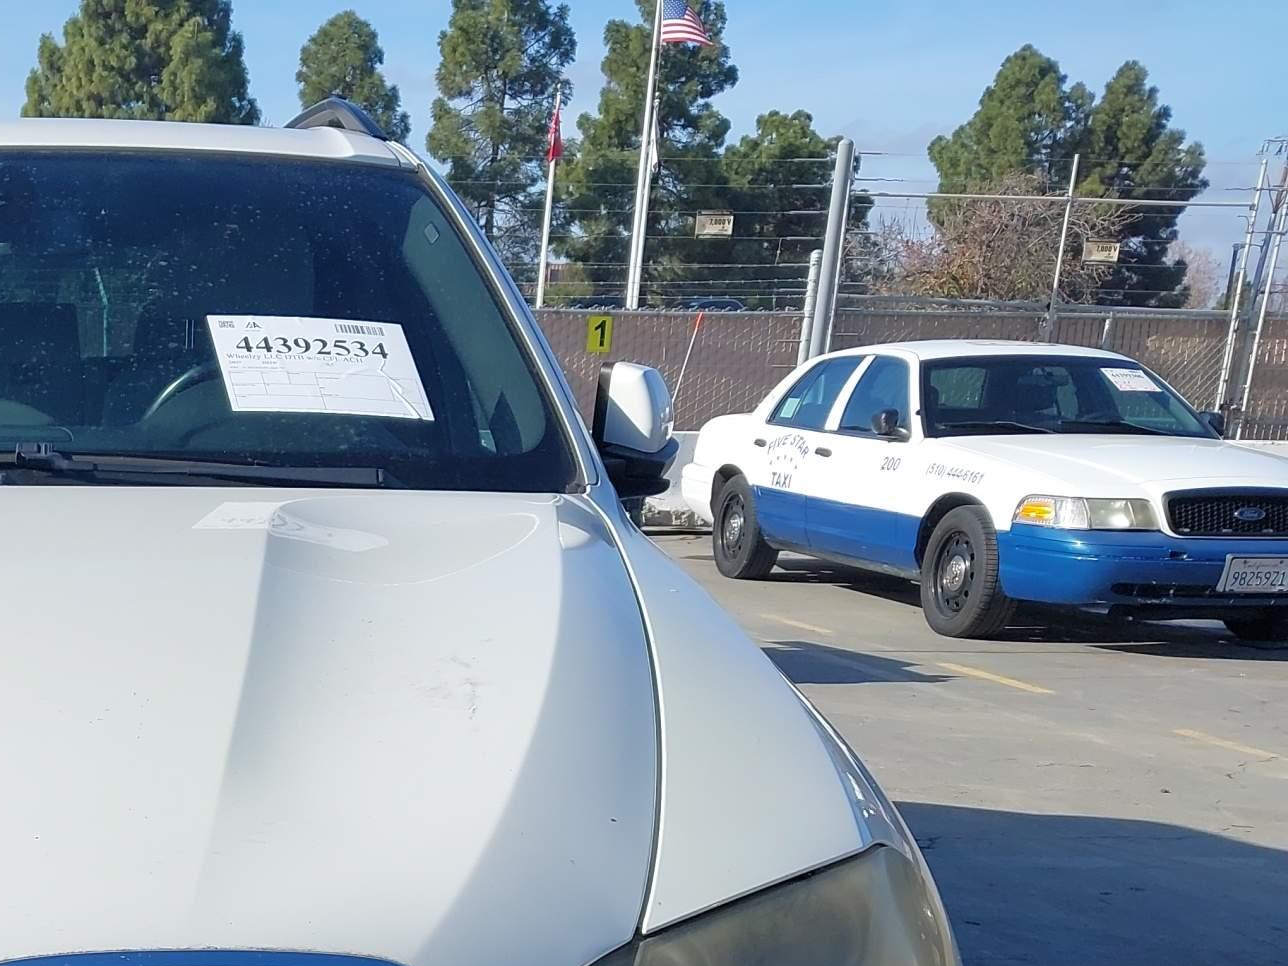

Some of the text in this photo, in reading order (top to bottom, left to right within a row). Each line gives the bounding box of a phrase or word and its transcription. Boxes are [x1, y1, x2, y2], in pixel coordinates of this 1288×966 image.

[594, 319, 607, 347] 1
[236, 335, 389, 360] 44392534
[768, 434, 809, 459] FIVE STAR
[880, 457, 901, 471] 200
[925, 463, 946, 478] (510)
[772, 472, 792, 488] TAXI
